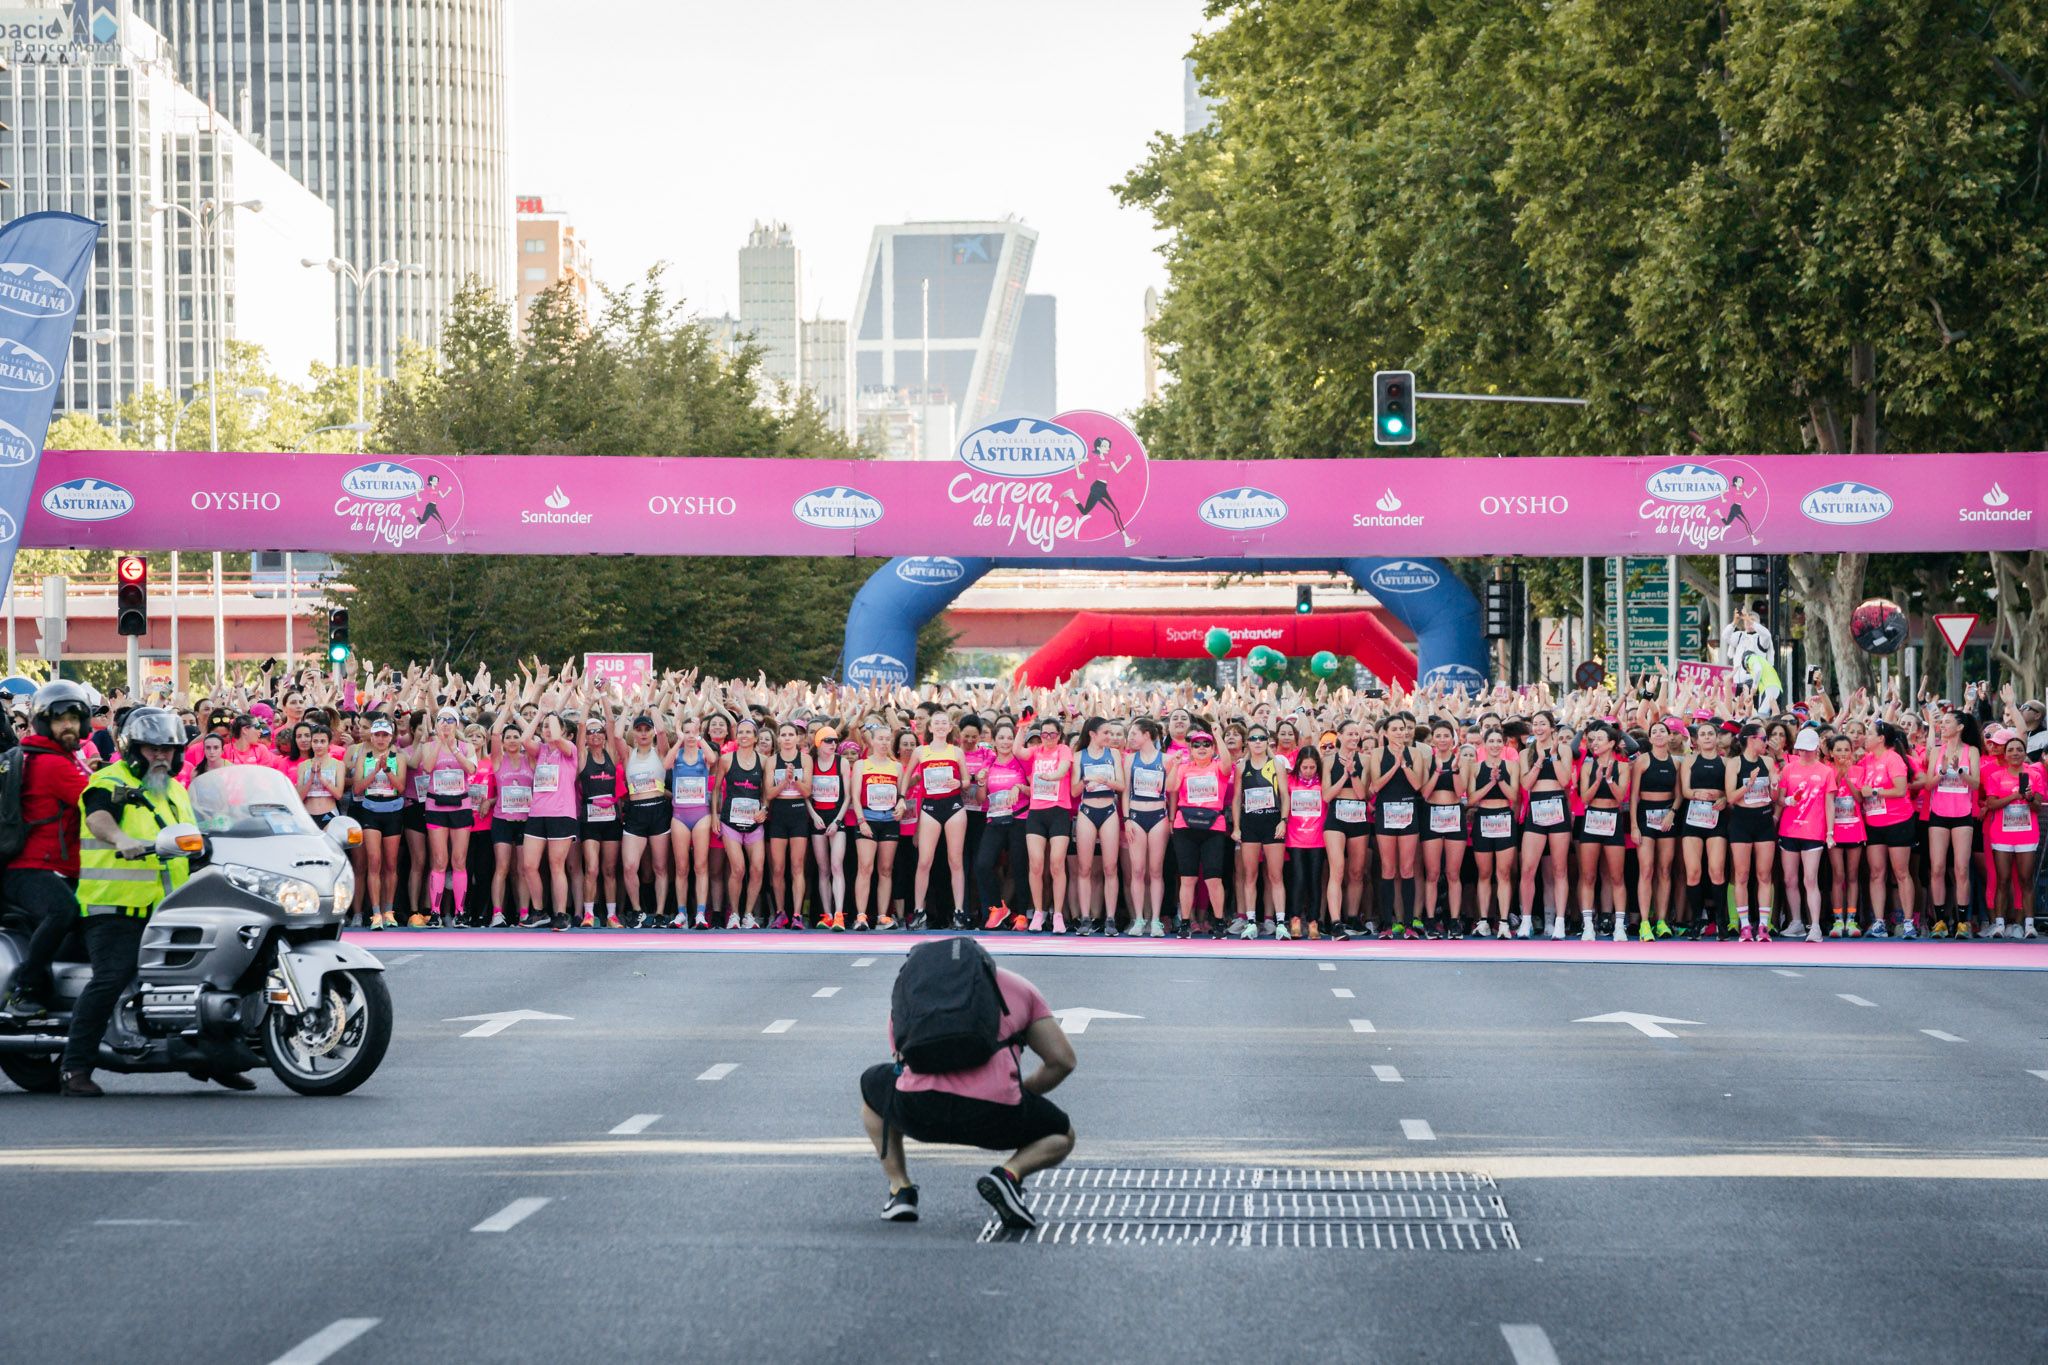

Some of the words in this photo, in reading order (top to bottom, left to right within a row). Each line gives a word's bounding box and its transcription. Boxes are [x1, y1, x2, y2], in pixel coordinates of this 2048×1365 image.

[0, 282, 66, 312] TURIANA
[970, 439, 1076, 462] ASTURIANA
[348, 476, 417, 490] ASTURIANA
[948, 472, 1054, 504] Carrera
[1653, 478, 1721, 494] ASTURIANA
[50, 493, 127, 510] ASTURIANA
[191, 491, 280, 511] OYSHO
[334, 496, 402, 517] Carrera
[648, 495, 736, 516] OYSHO
[1480, 495, 1569, 515] OYSHO
[1808, 498, 1885, 514] ASTURIANA
[521, 510, 593, 524] Santander
[801, 501, 877, 518] ASTURIANA
[1206, 503, 1281, 519] ASTURIANA
[1639, 500, 1706, 520] Carrera
[1959, 508, 2033, 522] Santander
[973, 505, 993, 527] de
[996, 505, 1011, 527] la
[1008, 501, 1092, 552] Mujer
[1353, 513, 1424, 527] Santander
[350, 518, 363, 531] de
[365, 517, 375, 532] la
[373, 515, 427, 548] Mujer
[1655, 520, 1668, 534] de
[1670, 520, 1680, 534] la
[1678, 514, 1732, 550] Mujer
[902, 564, 959, 578] ASTURIANA
[1376, 572, 1435, 585] ASTURIANA
[1631, 591, 1669, 600] Argentin
[1166, 627, 1204, 642] Sports
[1629, 639, 1669, 647] Villaverd
[595, 659, 625, 672] SUB
[1680, 665, 1711, 680] SUB
